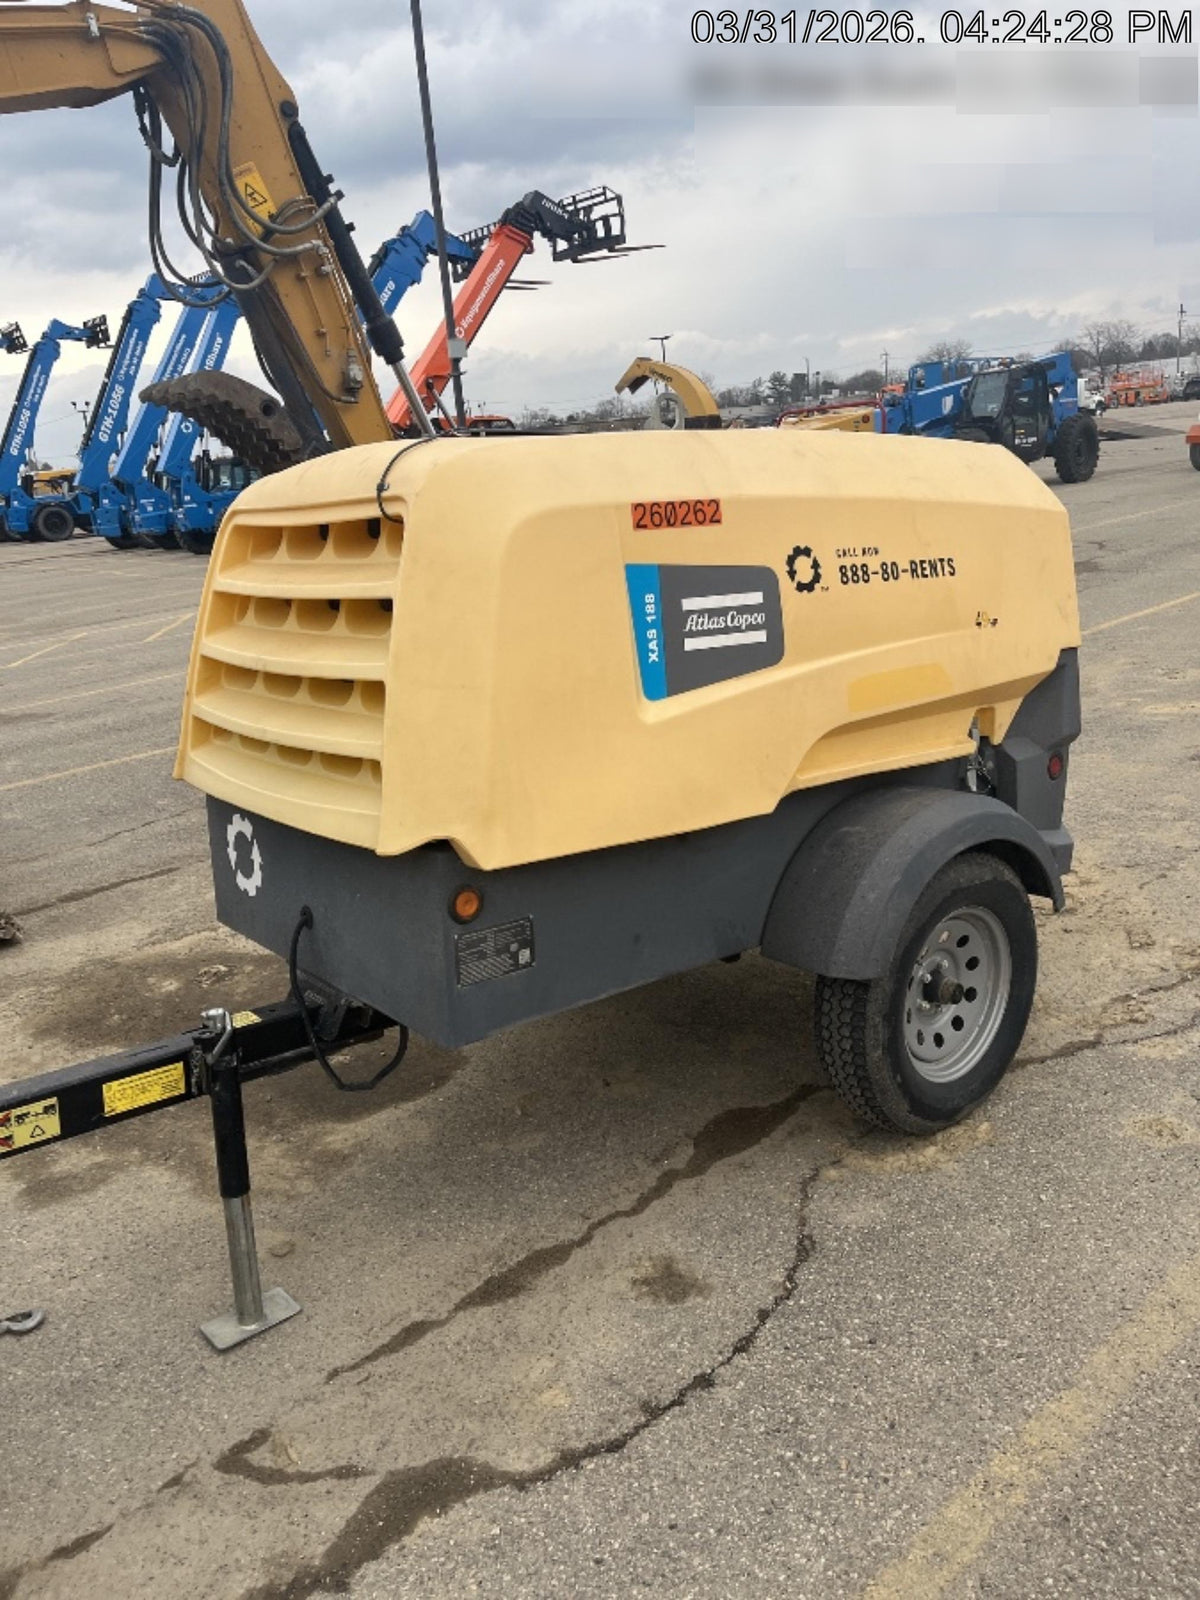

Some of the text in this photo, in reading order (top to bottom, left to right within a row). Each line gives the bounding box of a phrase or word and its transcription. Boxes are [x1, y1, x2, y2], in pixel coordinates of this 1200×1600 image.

[634, 499, 721, 529] 260262
[838, 557, 956, 586] 888-80-RENTS
[645, 593, 659, 664] XAS 188
[684, 610, 766, 632] Atlas Copco
